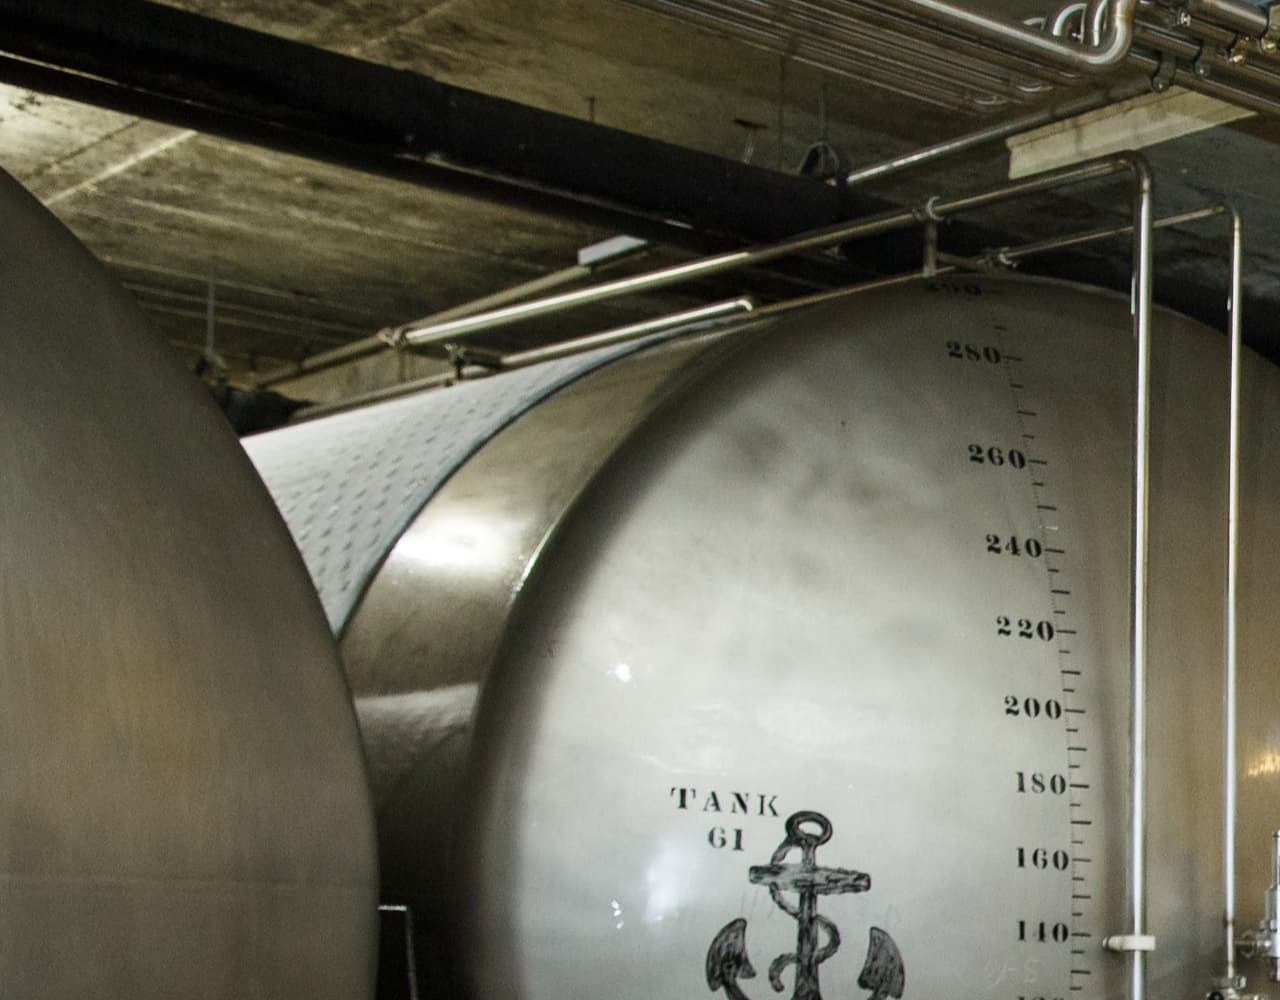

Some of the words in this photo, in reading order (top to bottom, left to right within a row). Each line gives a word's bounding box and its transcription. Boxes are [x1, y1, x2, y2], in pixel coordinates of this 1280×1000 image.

[946, 340, 1001, 365] 280
[968, 444, 1027, 470] 260
[986, 534, 1042, 558] 240
[997, 616, 1055, 642] 220
[1004, 695, 1062, 720] 200
[1016, 772, 1067, 795] 180
[670, 787, 779, 817] TANK
[708, 826, 745, 852] 61
[1016, 848, 1069, 872] 160
[1017, 920, 1069, 943] 140
